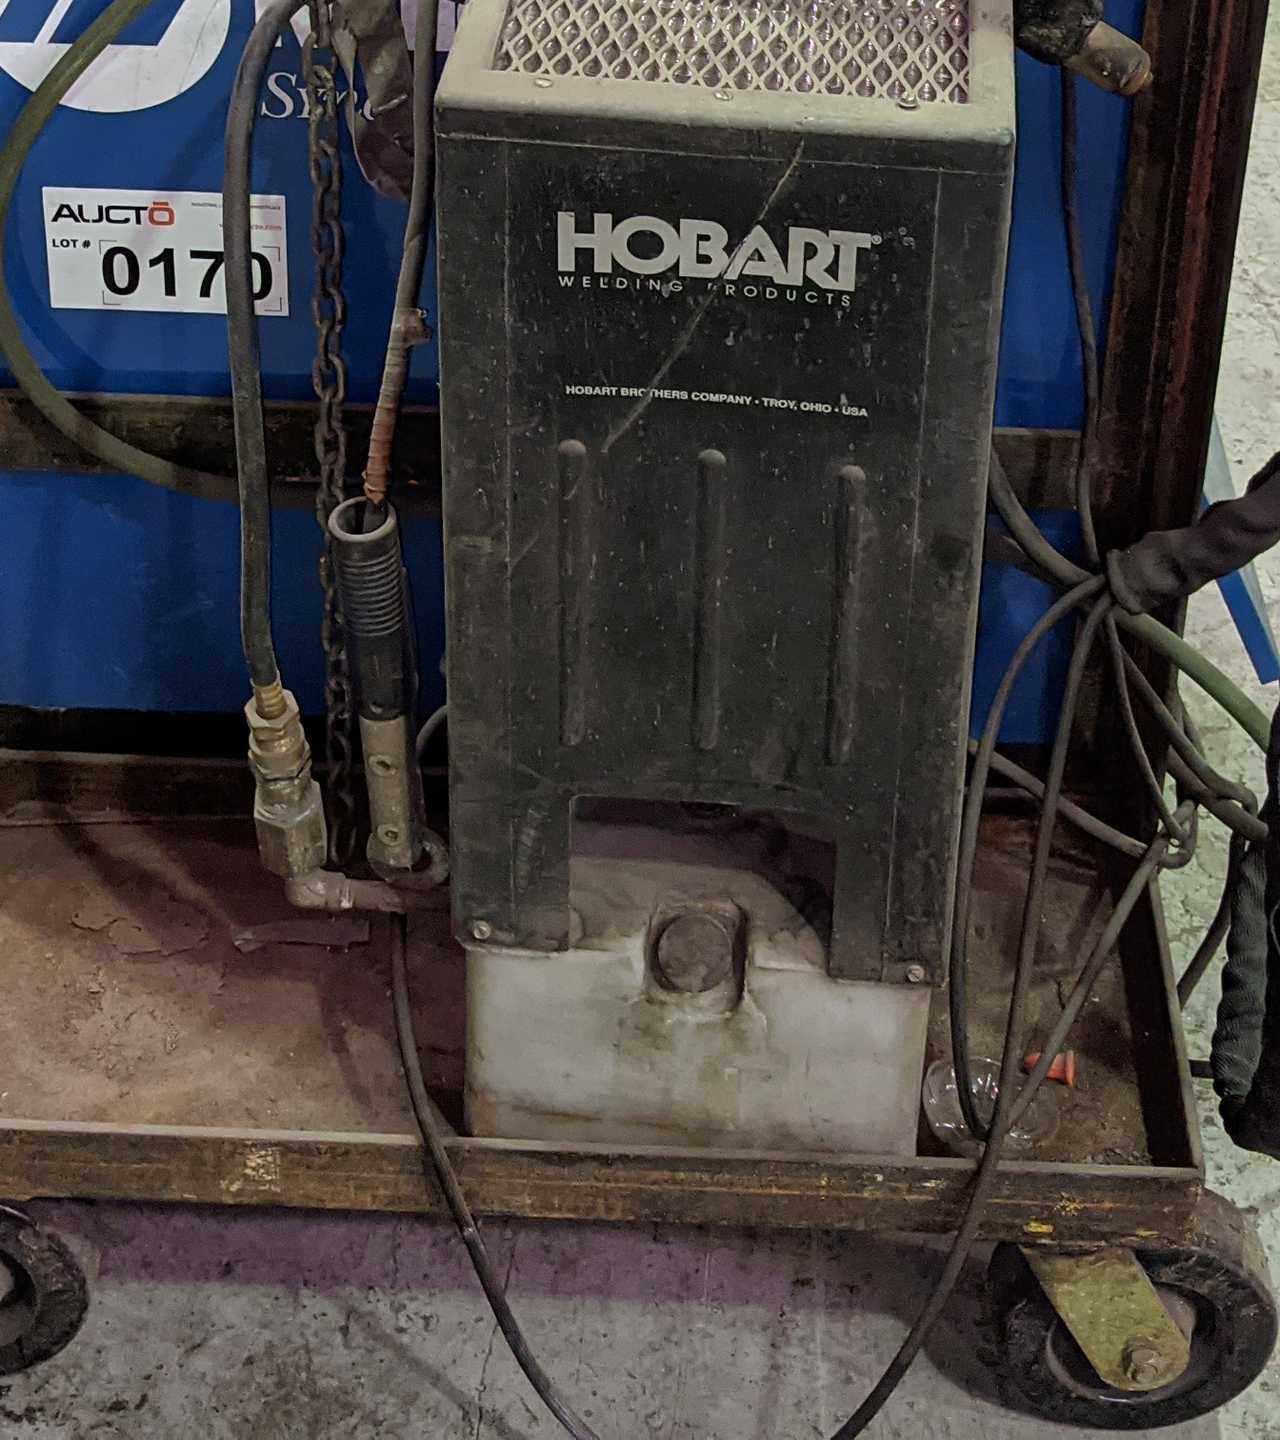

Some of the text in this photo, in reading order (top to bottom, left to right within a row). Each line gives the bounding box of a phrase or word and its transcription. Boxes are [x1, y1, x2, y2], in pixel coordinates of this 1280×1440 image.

[52, 239, 79, 248] LOT
[557, 211, 872, 292] HOBART
[558, 275, 684, 293] WELDING
[565, 385, 619, 396] HOBART
[691, 391, 752, 405] COMPANY
[761, 397, 798, 410] TROY,
[800, 401, 832, 413] OHIO
[841, 406, 868, 417] USA
